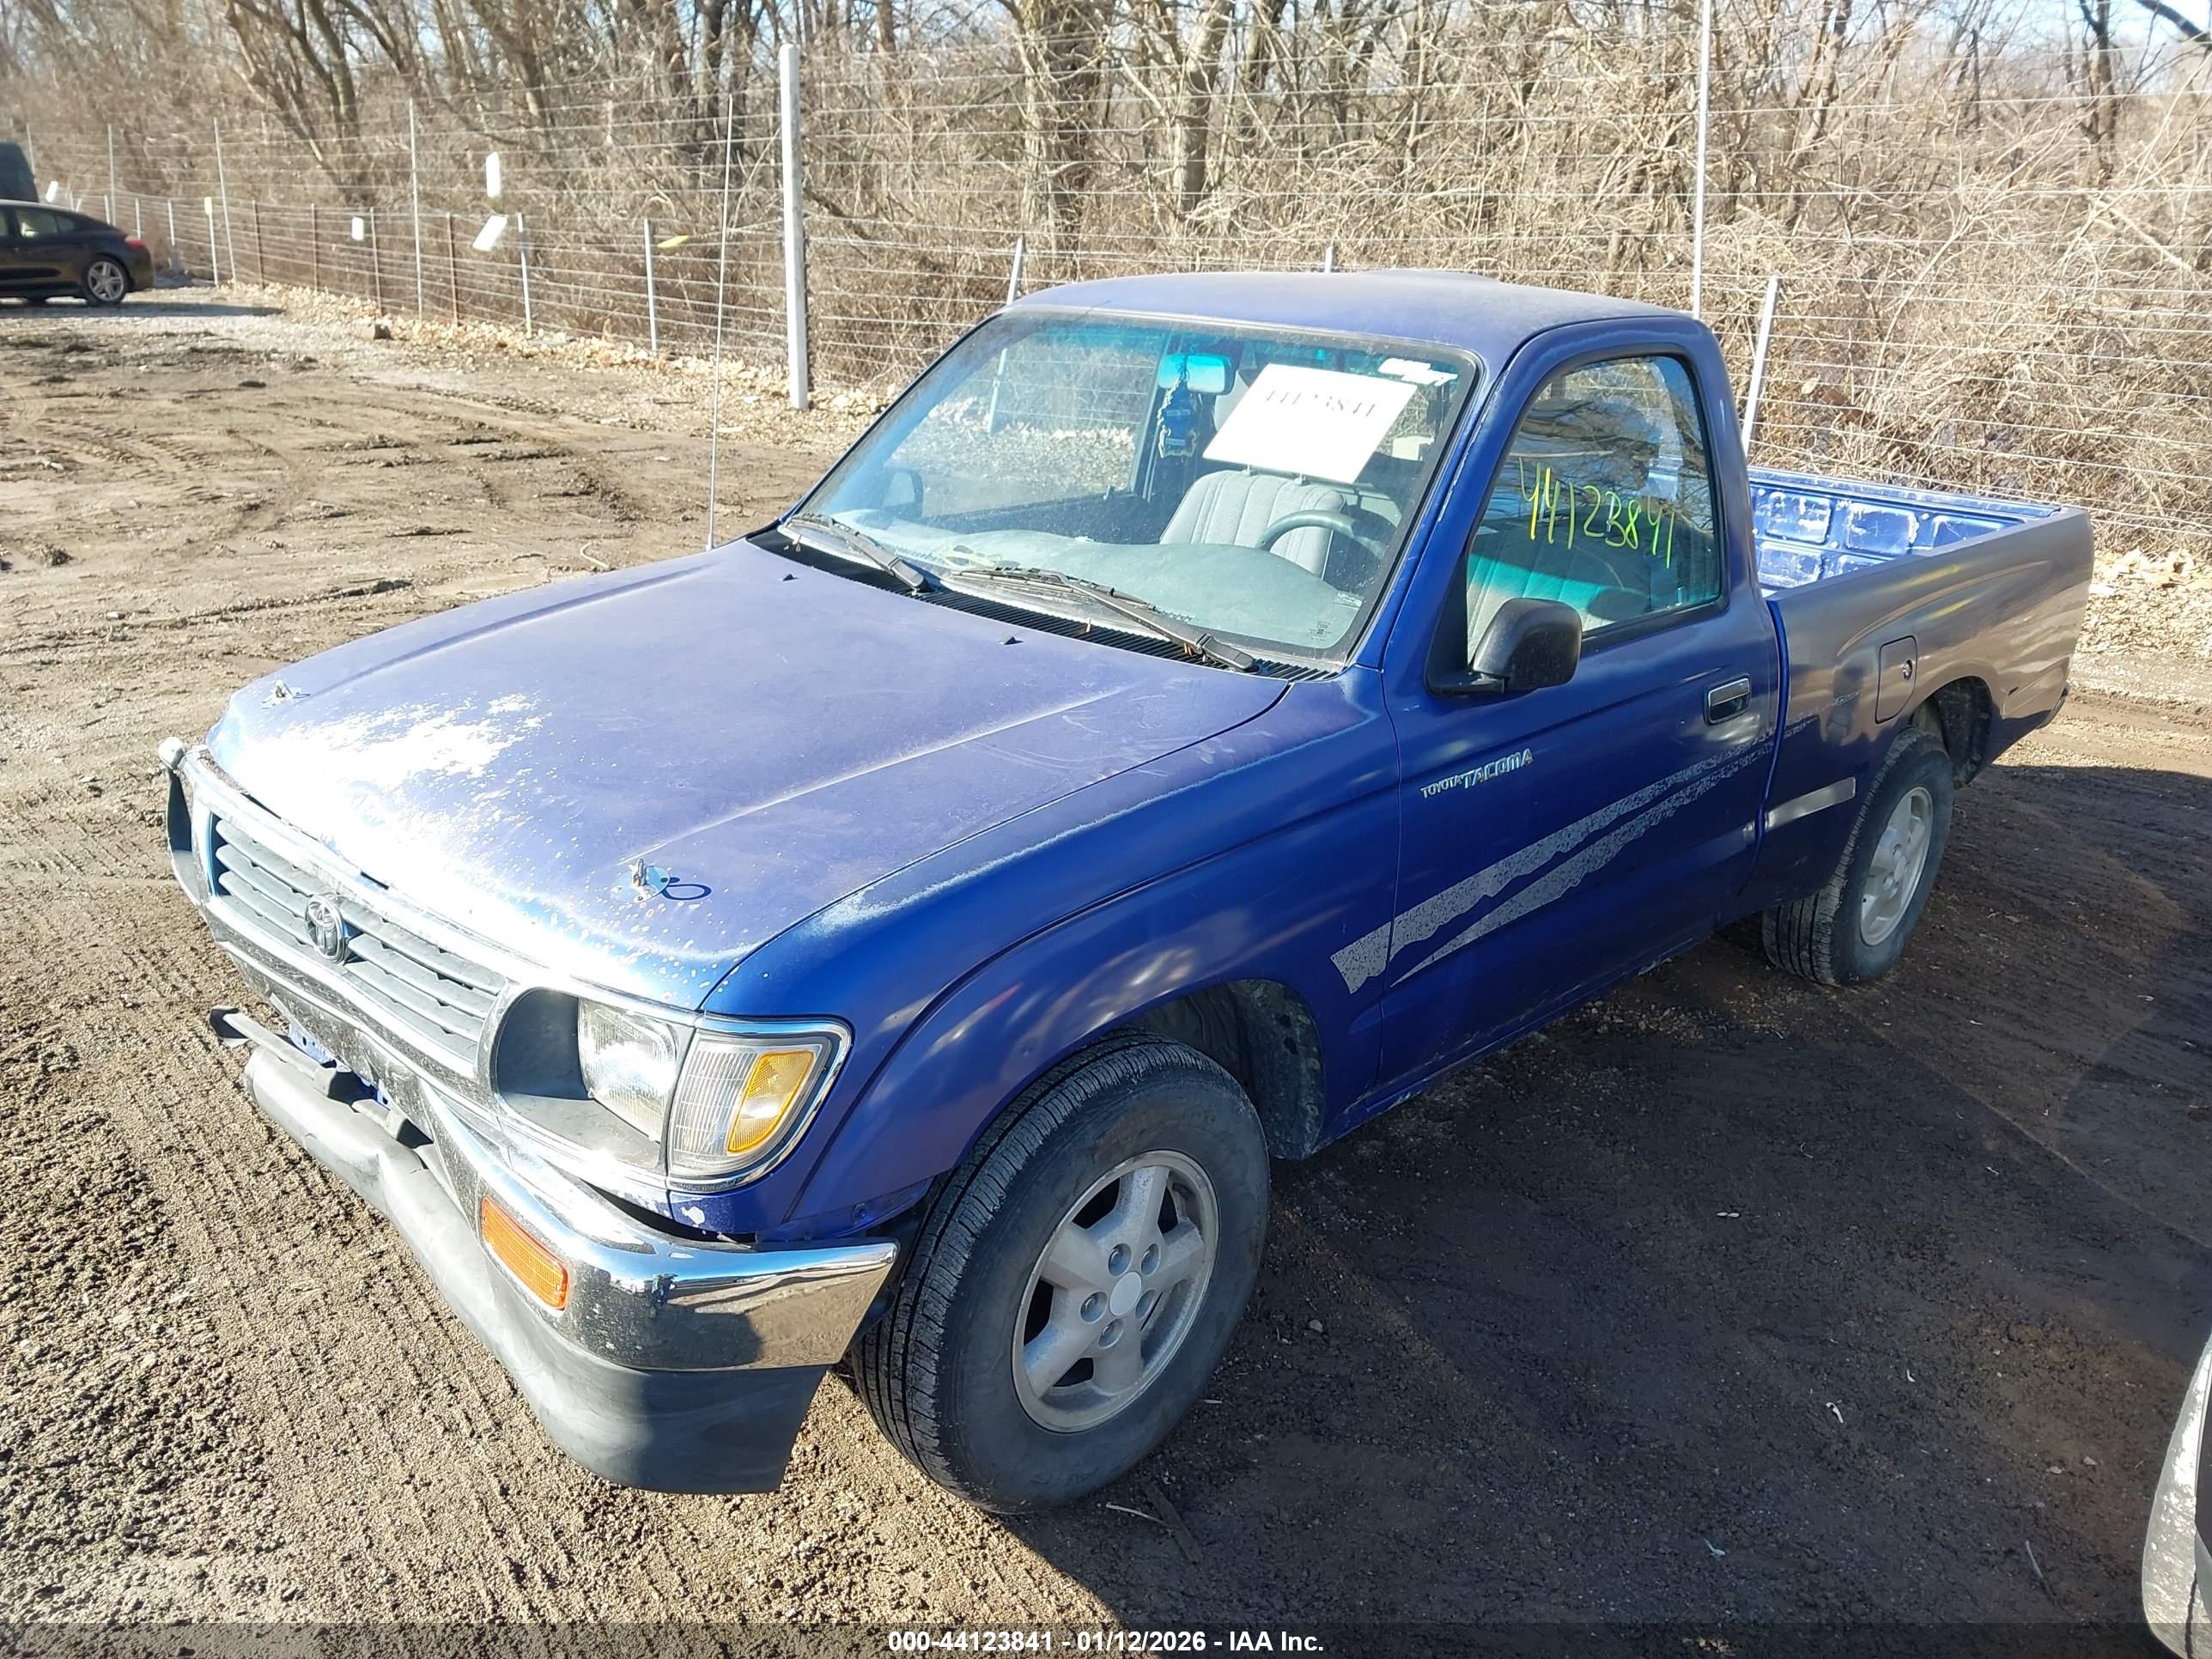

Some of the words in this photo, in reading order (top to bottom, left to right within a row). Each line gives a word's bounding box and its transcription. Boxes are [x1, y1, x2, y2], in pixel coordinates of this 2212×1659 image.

[1519, 456, 1675, 570] 44123841
[1420, 775, 1462, 799] TOYOTA
[1462, 748, 1534, 789] TACOMA
